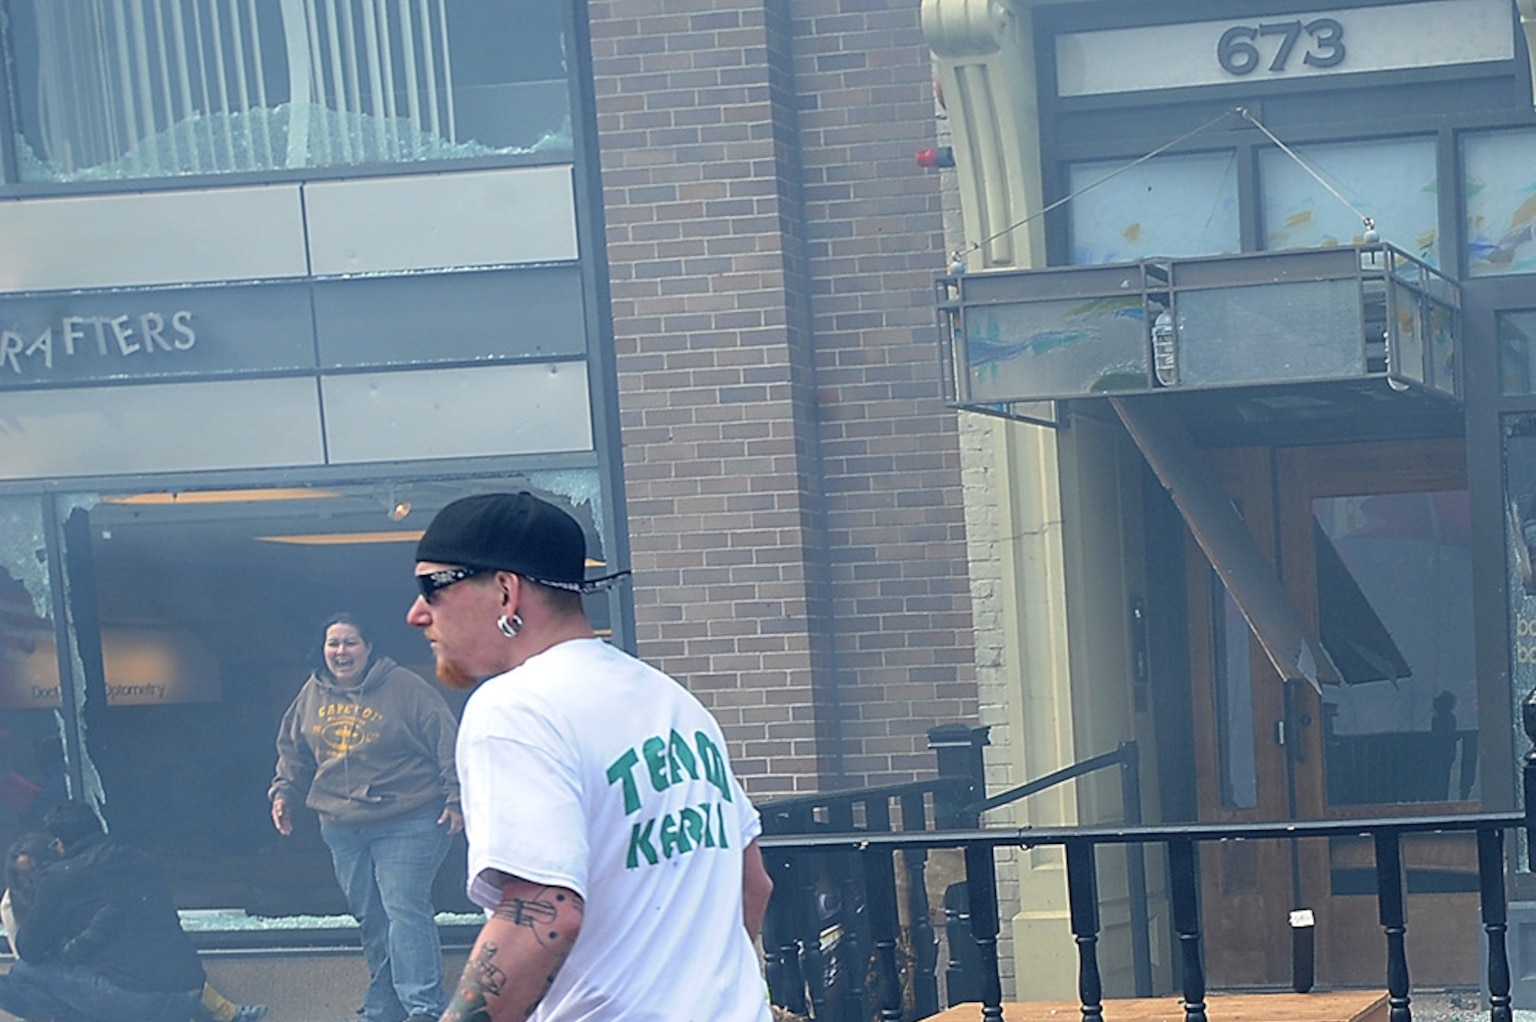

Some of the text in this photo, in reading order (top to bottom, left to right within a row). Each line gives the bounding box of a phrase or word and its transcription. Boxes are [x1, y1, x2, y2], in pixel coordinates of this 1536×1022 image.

[1217, 18, 1346, 75] 673
[0, 310, 196, 373] RAFTERS
[606, 728, 732, 816] TEAM
